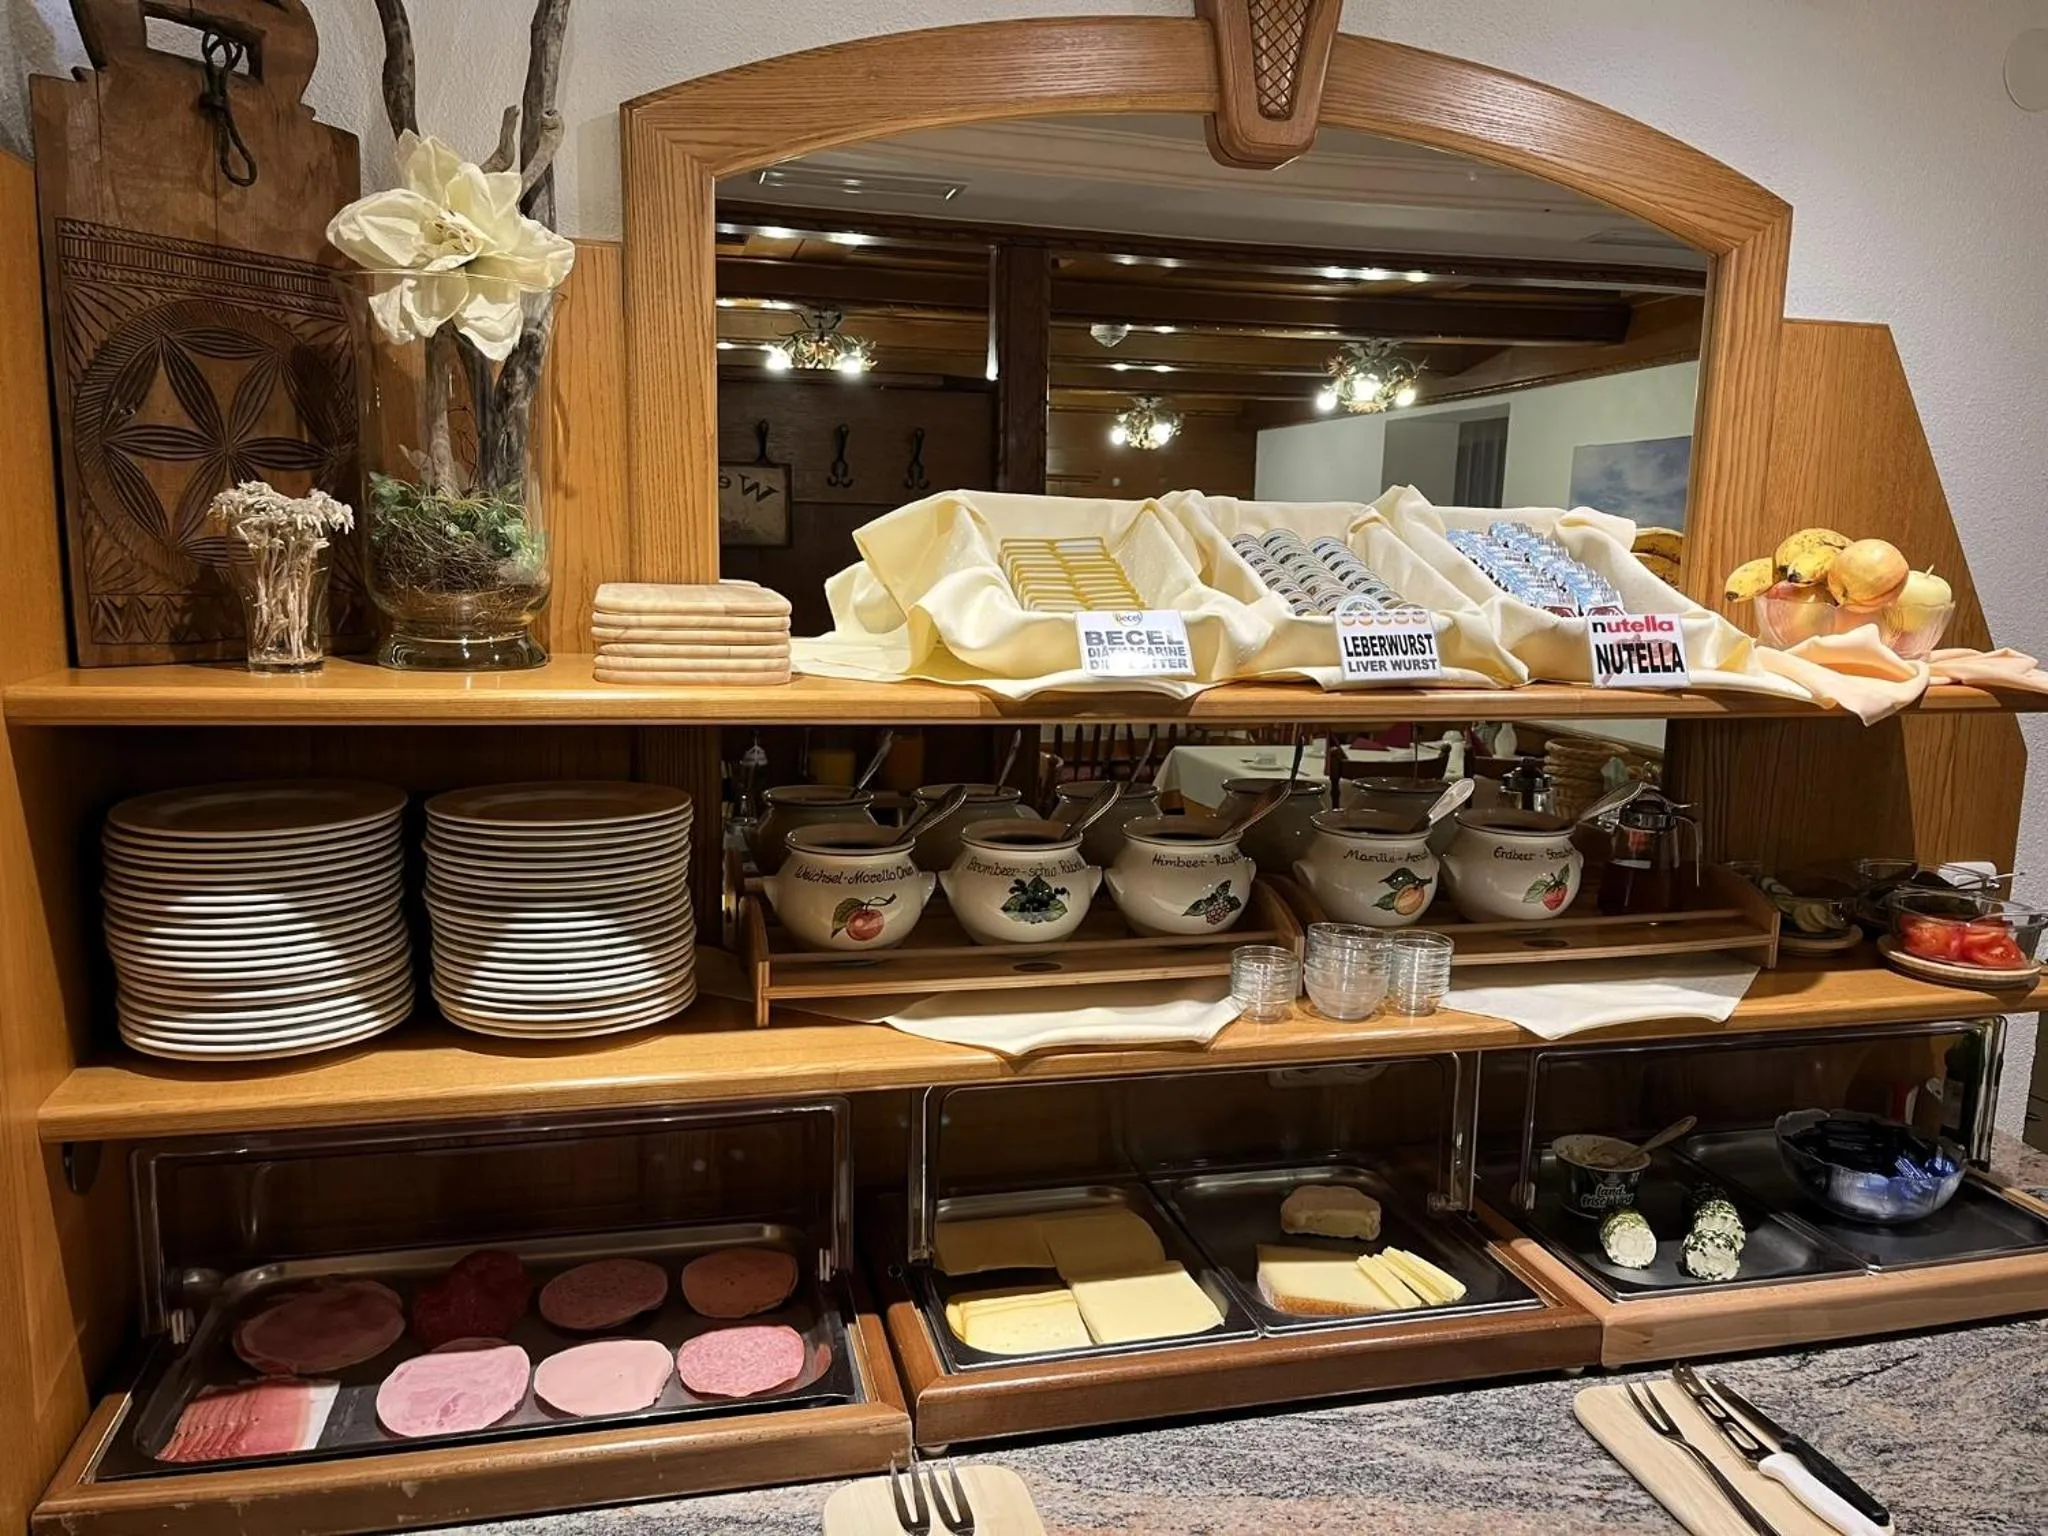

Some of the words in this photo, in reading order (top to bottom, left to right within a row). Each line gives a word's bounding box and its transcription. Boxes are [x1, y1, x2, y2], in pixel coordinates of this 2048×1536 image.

[1592, 615, 1674, 633] nutella
[1084, 630, 1184, 646] BECEL
[1343, 634, 1434, 657] LEBERWURST
[1347, 660, 1388, 673] LIVER
[1390, 659, 1437, 671] WURST
[1595, 642, 1685, 675] NUTELLA
